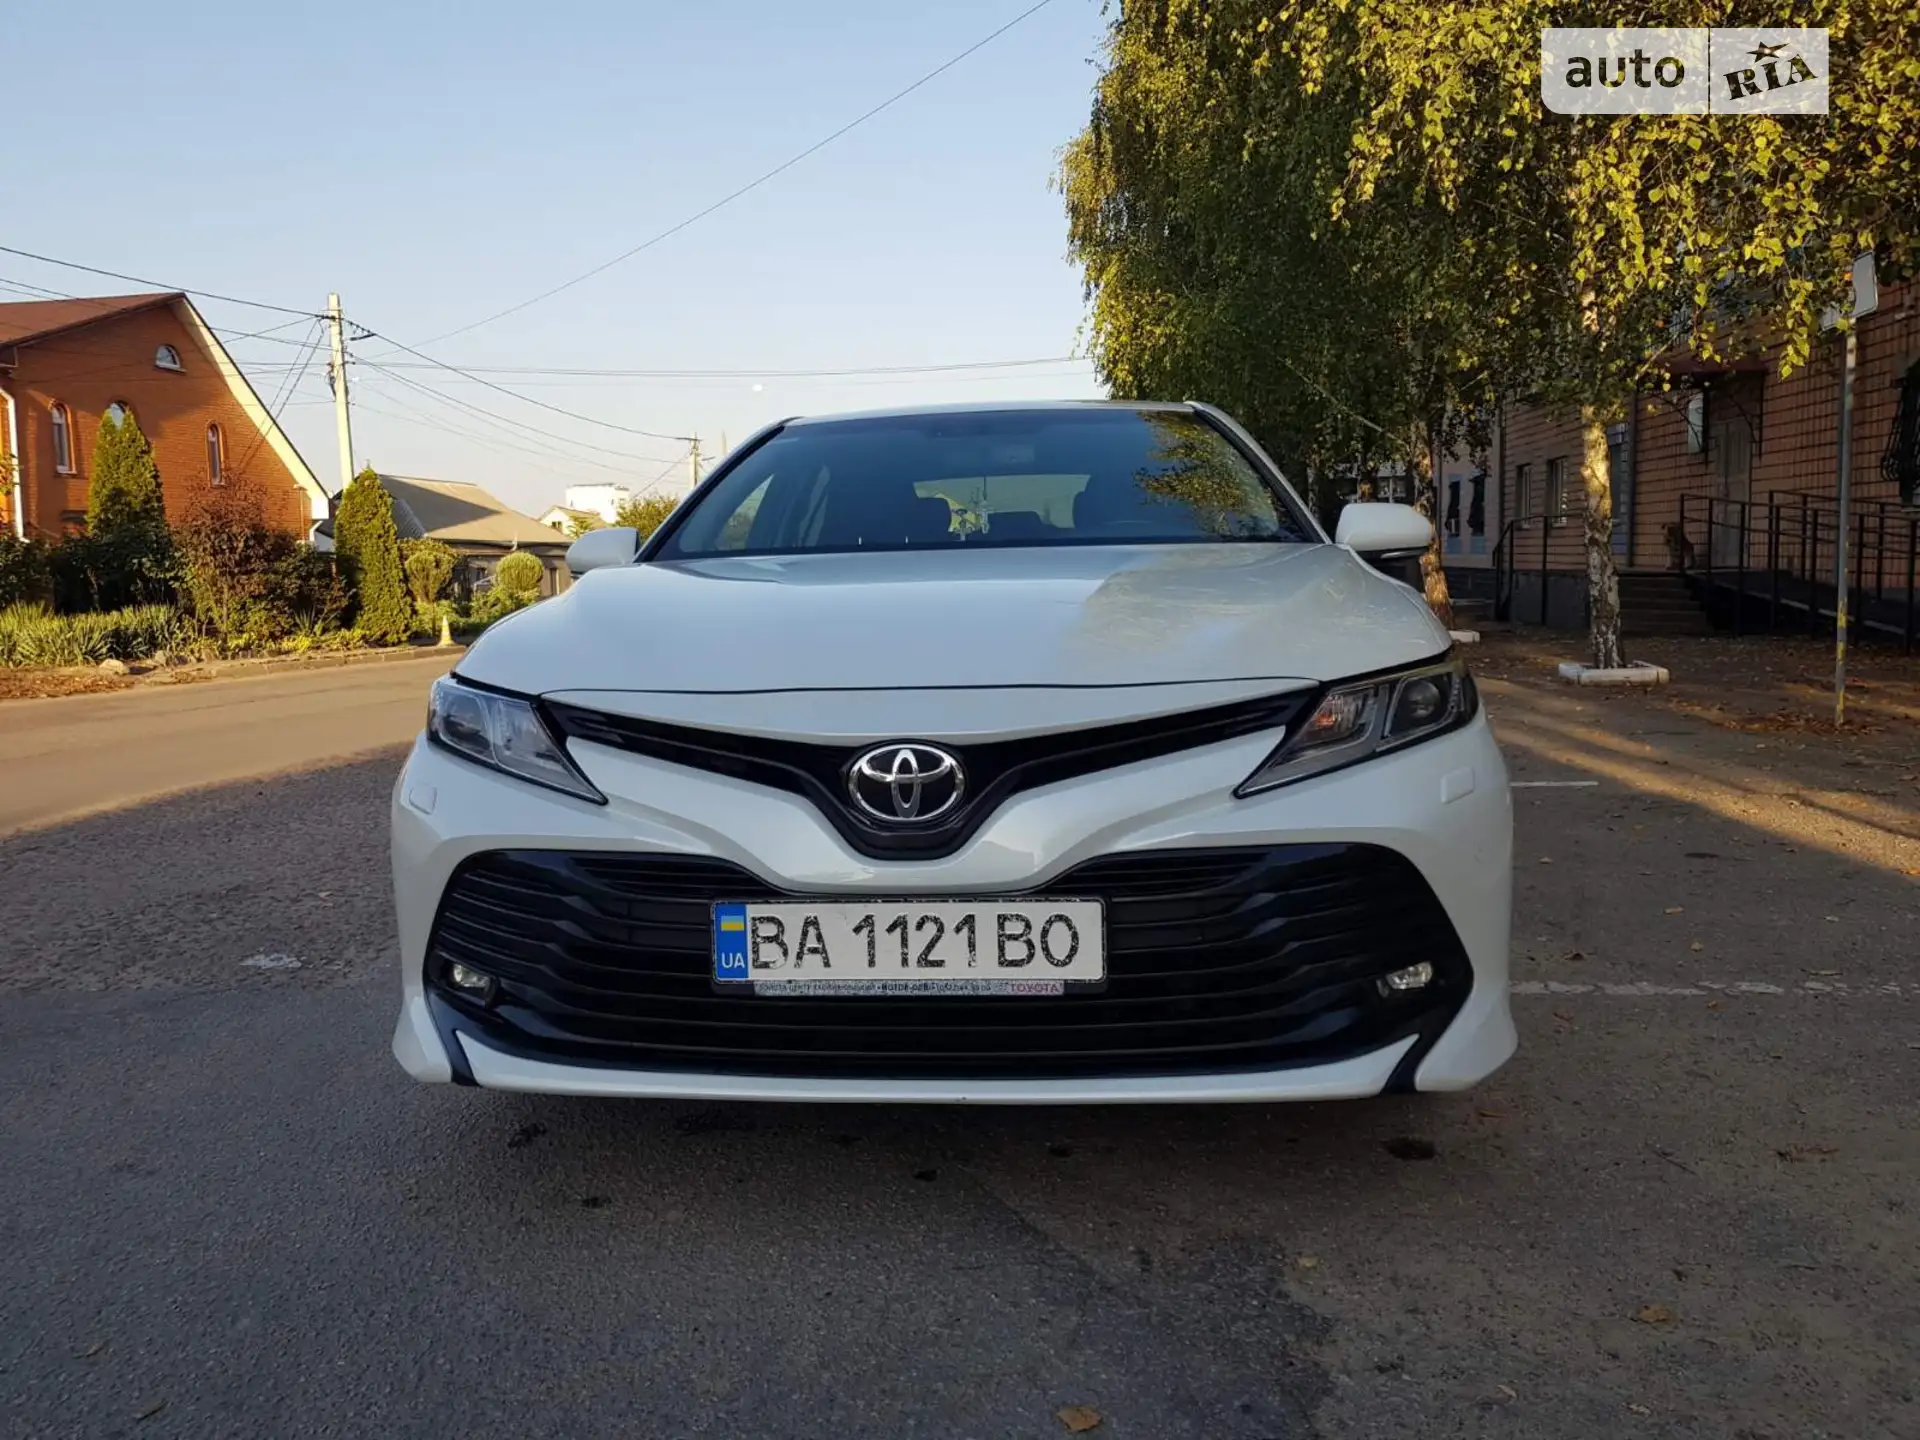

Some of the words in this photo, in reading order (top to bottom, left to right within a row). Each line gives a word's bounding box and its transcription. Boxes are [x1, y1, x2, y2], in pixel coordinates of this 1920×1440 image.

[750, 914, 832, 970] BA
[852, 913, 977, 969] 1121
[997, 913, 1080, 968] BO
[721, 952, 745, 969] UA
[1010, 983, 1060, 994] TOYOTA
